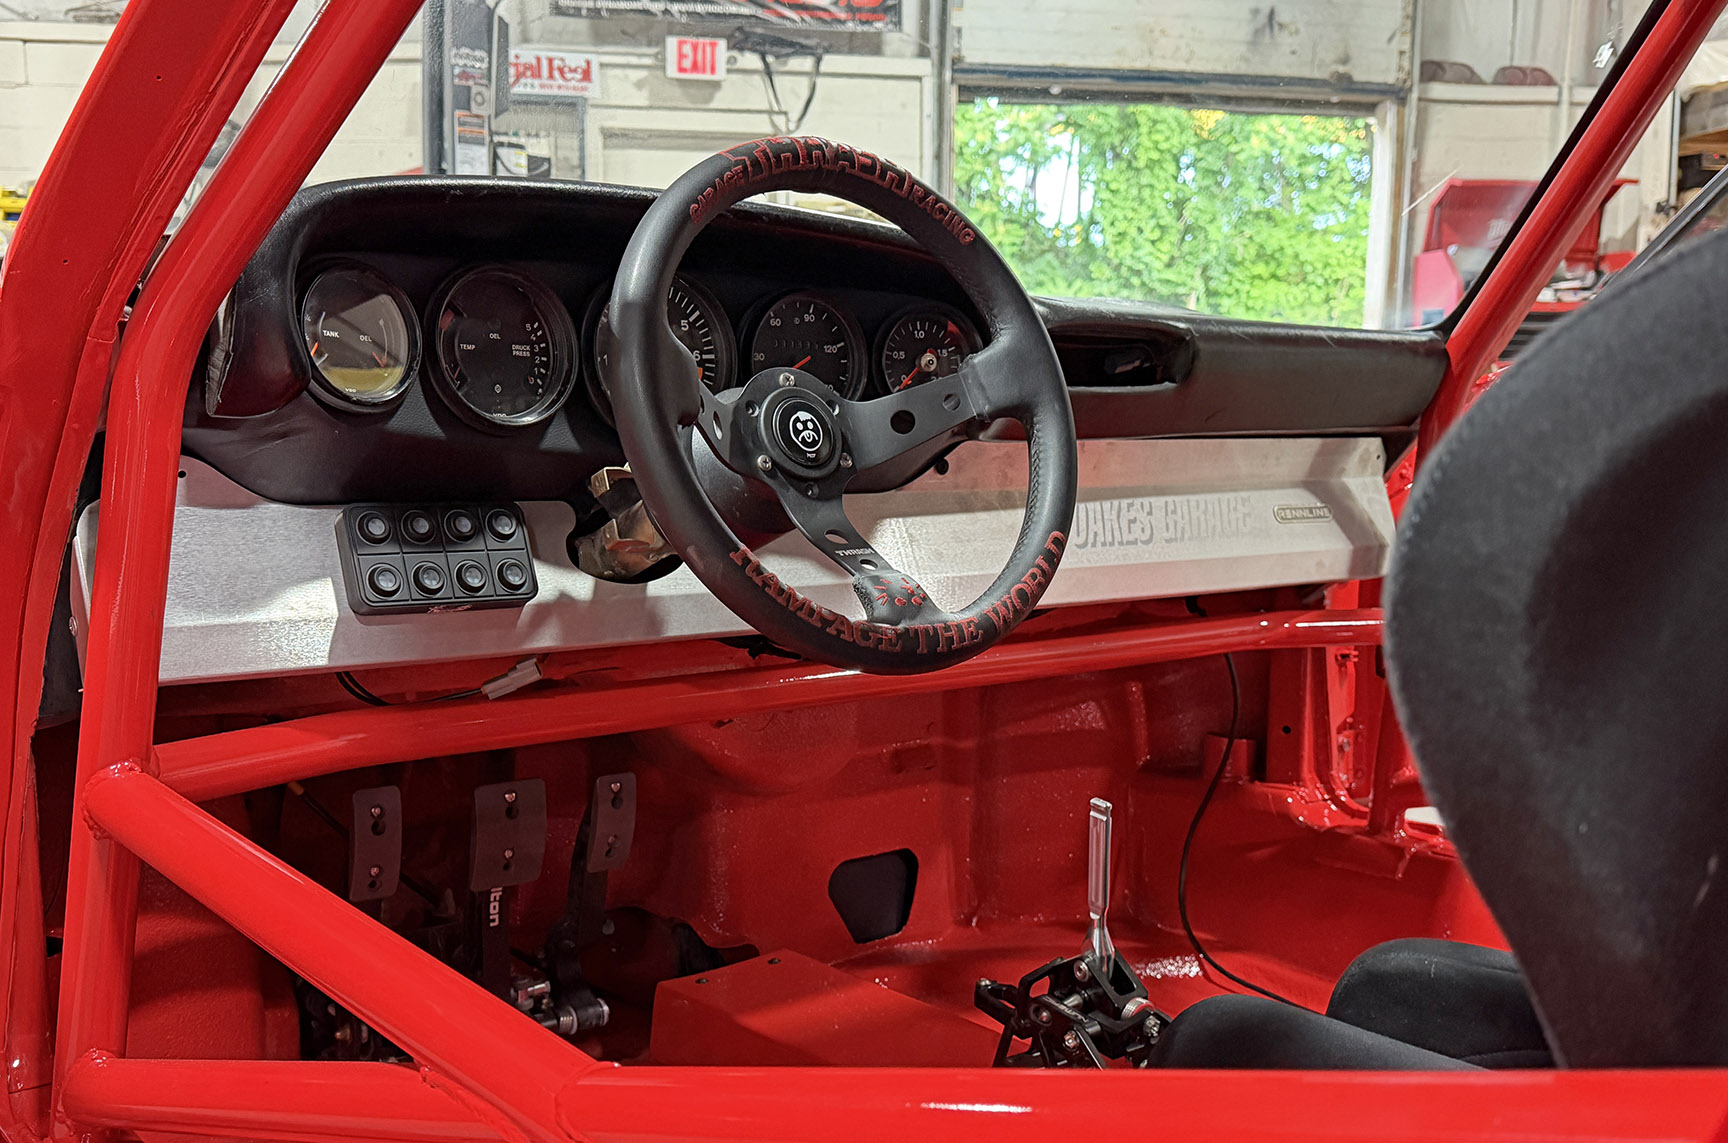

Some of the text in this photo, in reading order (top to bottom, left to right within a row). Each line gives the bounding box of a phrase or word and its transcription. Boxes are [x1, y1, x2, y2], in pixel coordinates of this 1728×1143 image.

[677, 39, 718, 75] EXIT
[910, 188, 976, 245] RACING
[770, 318, 781, 327] 60
[804, 314, 815, 322] 90
[525, 323, 531, 331] 5
[681, 320, 689, 331] 5
[323, 330, 339, 338] TANK
[824, 345, 838, 353] 120
[603, 354, 608, 366] 1
[693, 350, 701, 361] 6
[534, 367, 538, 375] 1
[1075, 496, 1251, 549] JAKES GARAGE
[834, 547, 875, 556] THRASH
[730, 531, 1067, 654] RAMPAGE THE WORLD
[489, 887, 503, 927] lton
